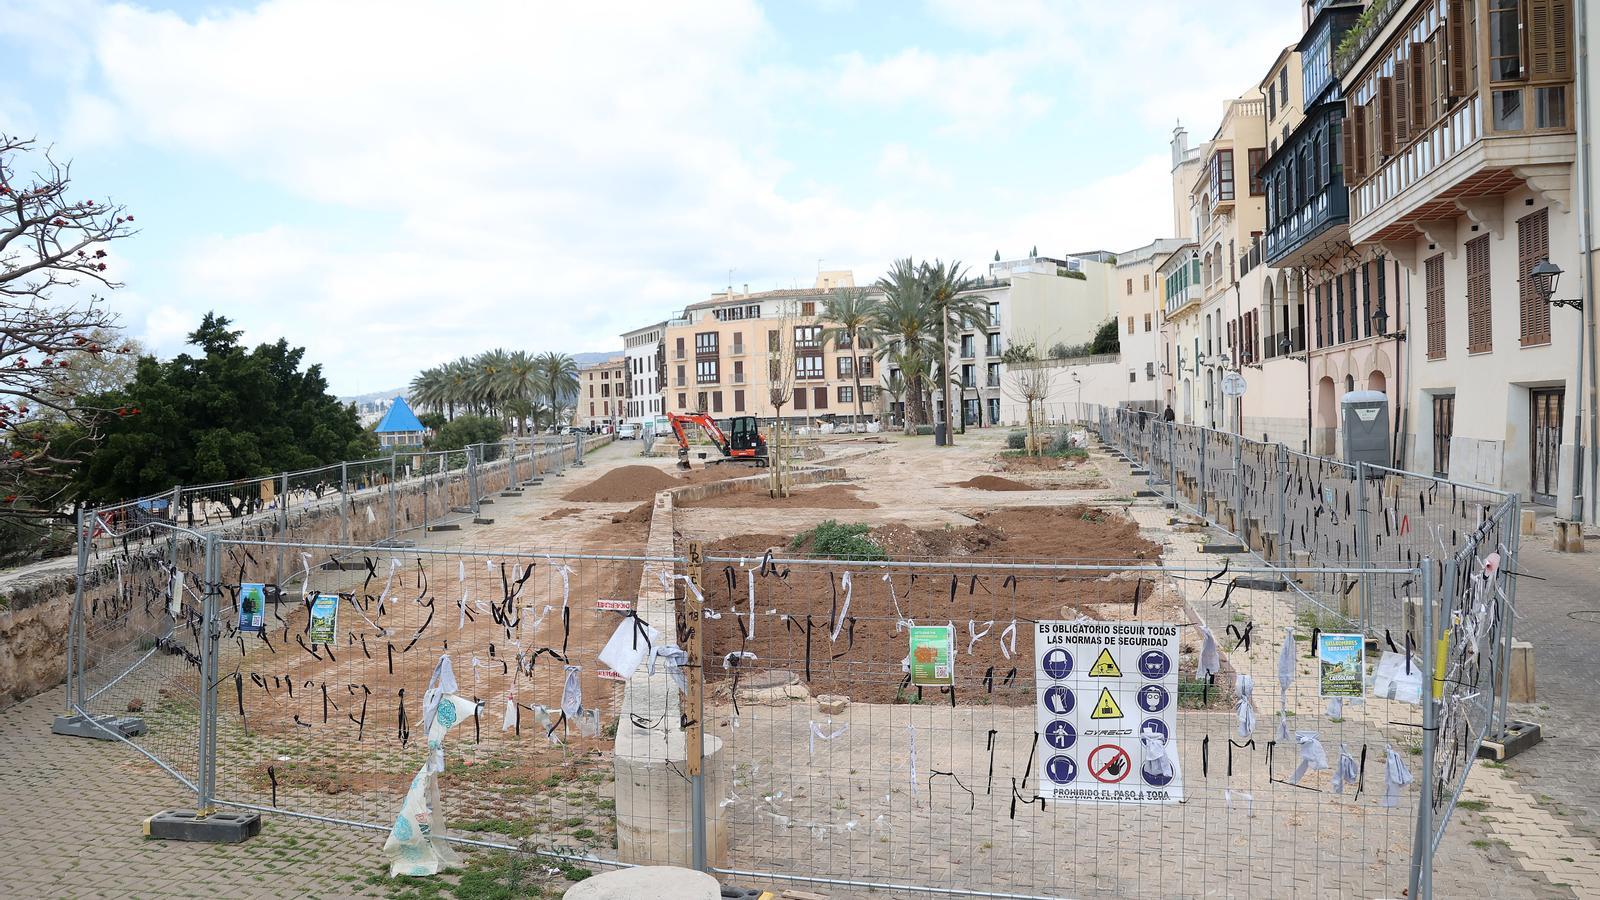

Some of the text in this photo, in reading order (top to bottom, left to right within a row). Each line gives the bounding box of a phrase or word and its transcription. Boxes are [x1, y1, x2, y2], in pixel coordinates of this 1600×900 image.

[1039, 624, 1177, 636] ES OBLIGATORIO SEGUIR TODAS
[1047, 635, 1168, 647] LAS NORMAS DE SEGURIDAD
[1053, 788, 1099, 796] PROHIBIDO
[1101, 789, 1111, 797] EL
